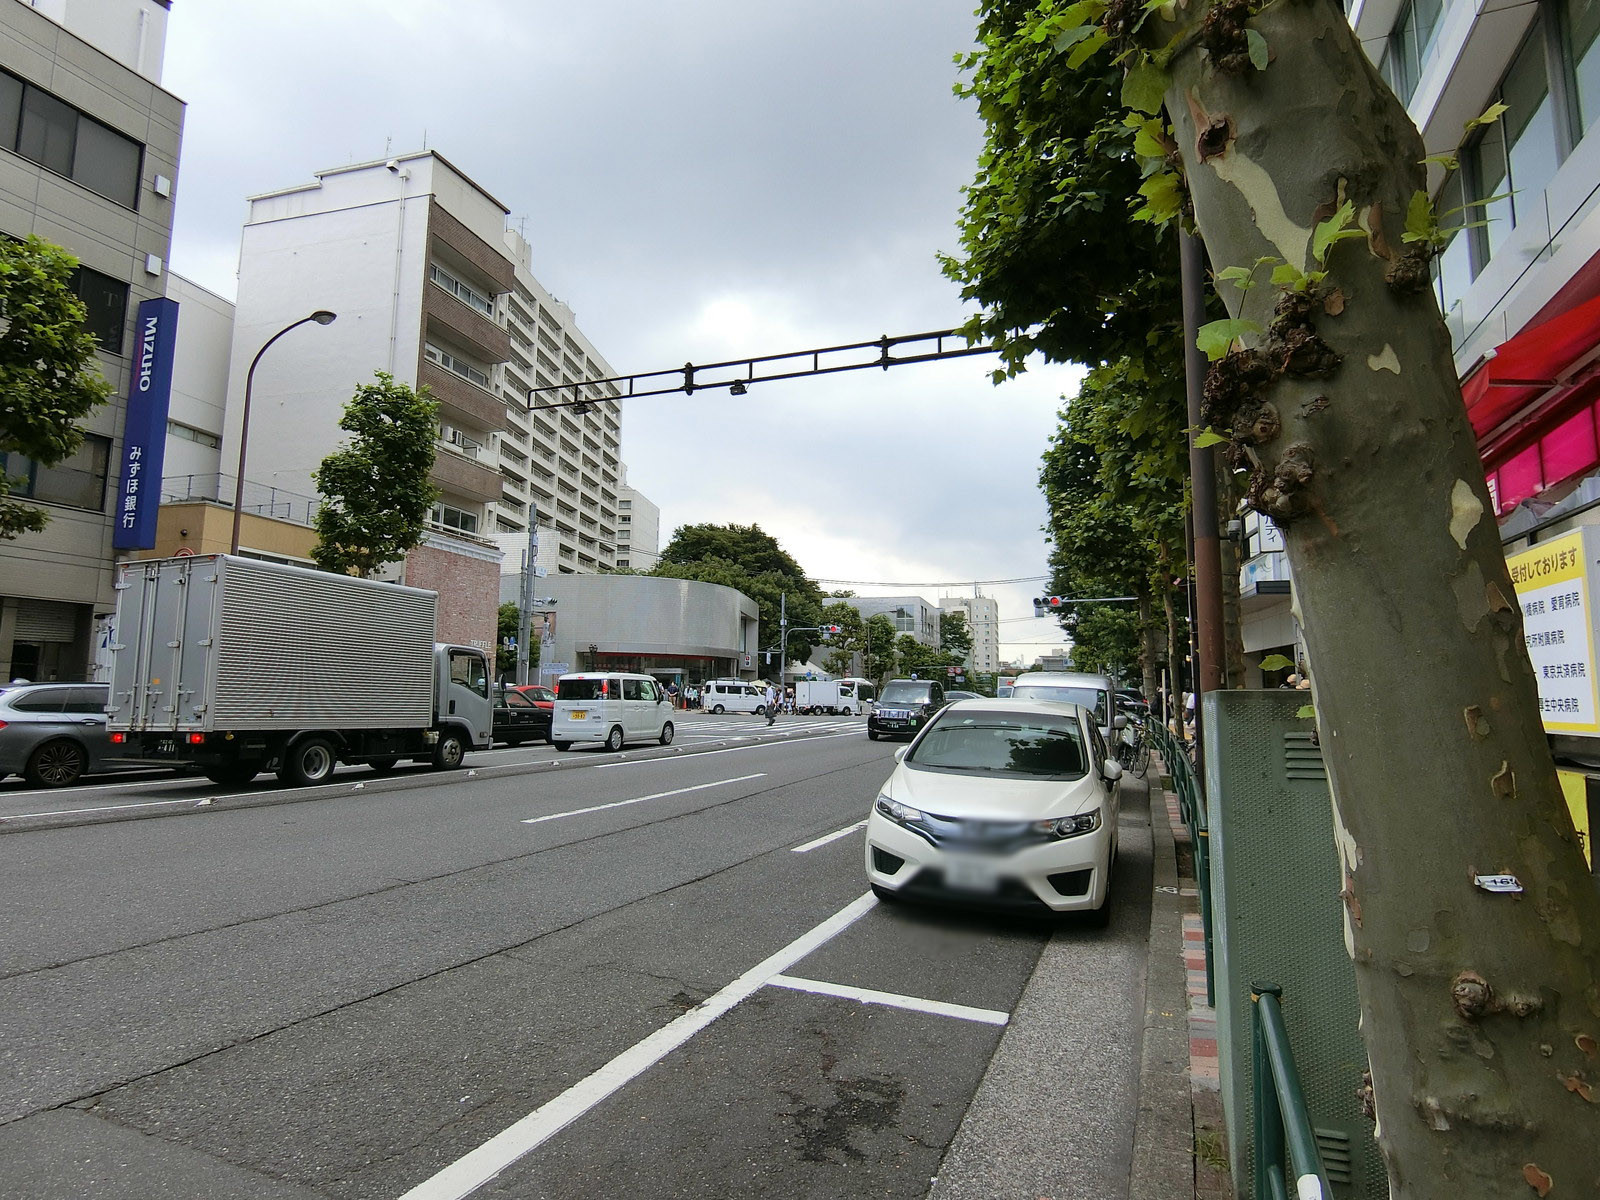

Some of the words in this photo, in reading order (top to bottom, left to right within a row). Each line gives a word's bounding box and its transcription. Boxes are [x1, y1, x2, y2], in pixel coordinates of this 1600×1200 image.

[139, 316, 158, 392] MIZUHO
[122, 446, 142, 529] みずほ銀行
[1511, 546, 1578, 584] 受付しております
[1551, 591, 1581, 612] 愛育病院
[1542, 662, 1586, 679] 東京共済病院
